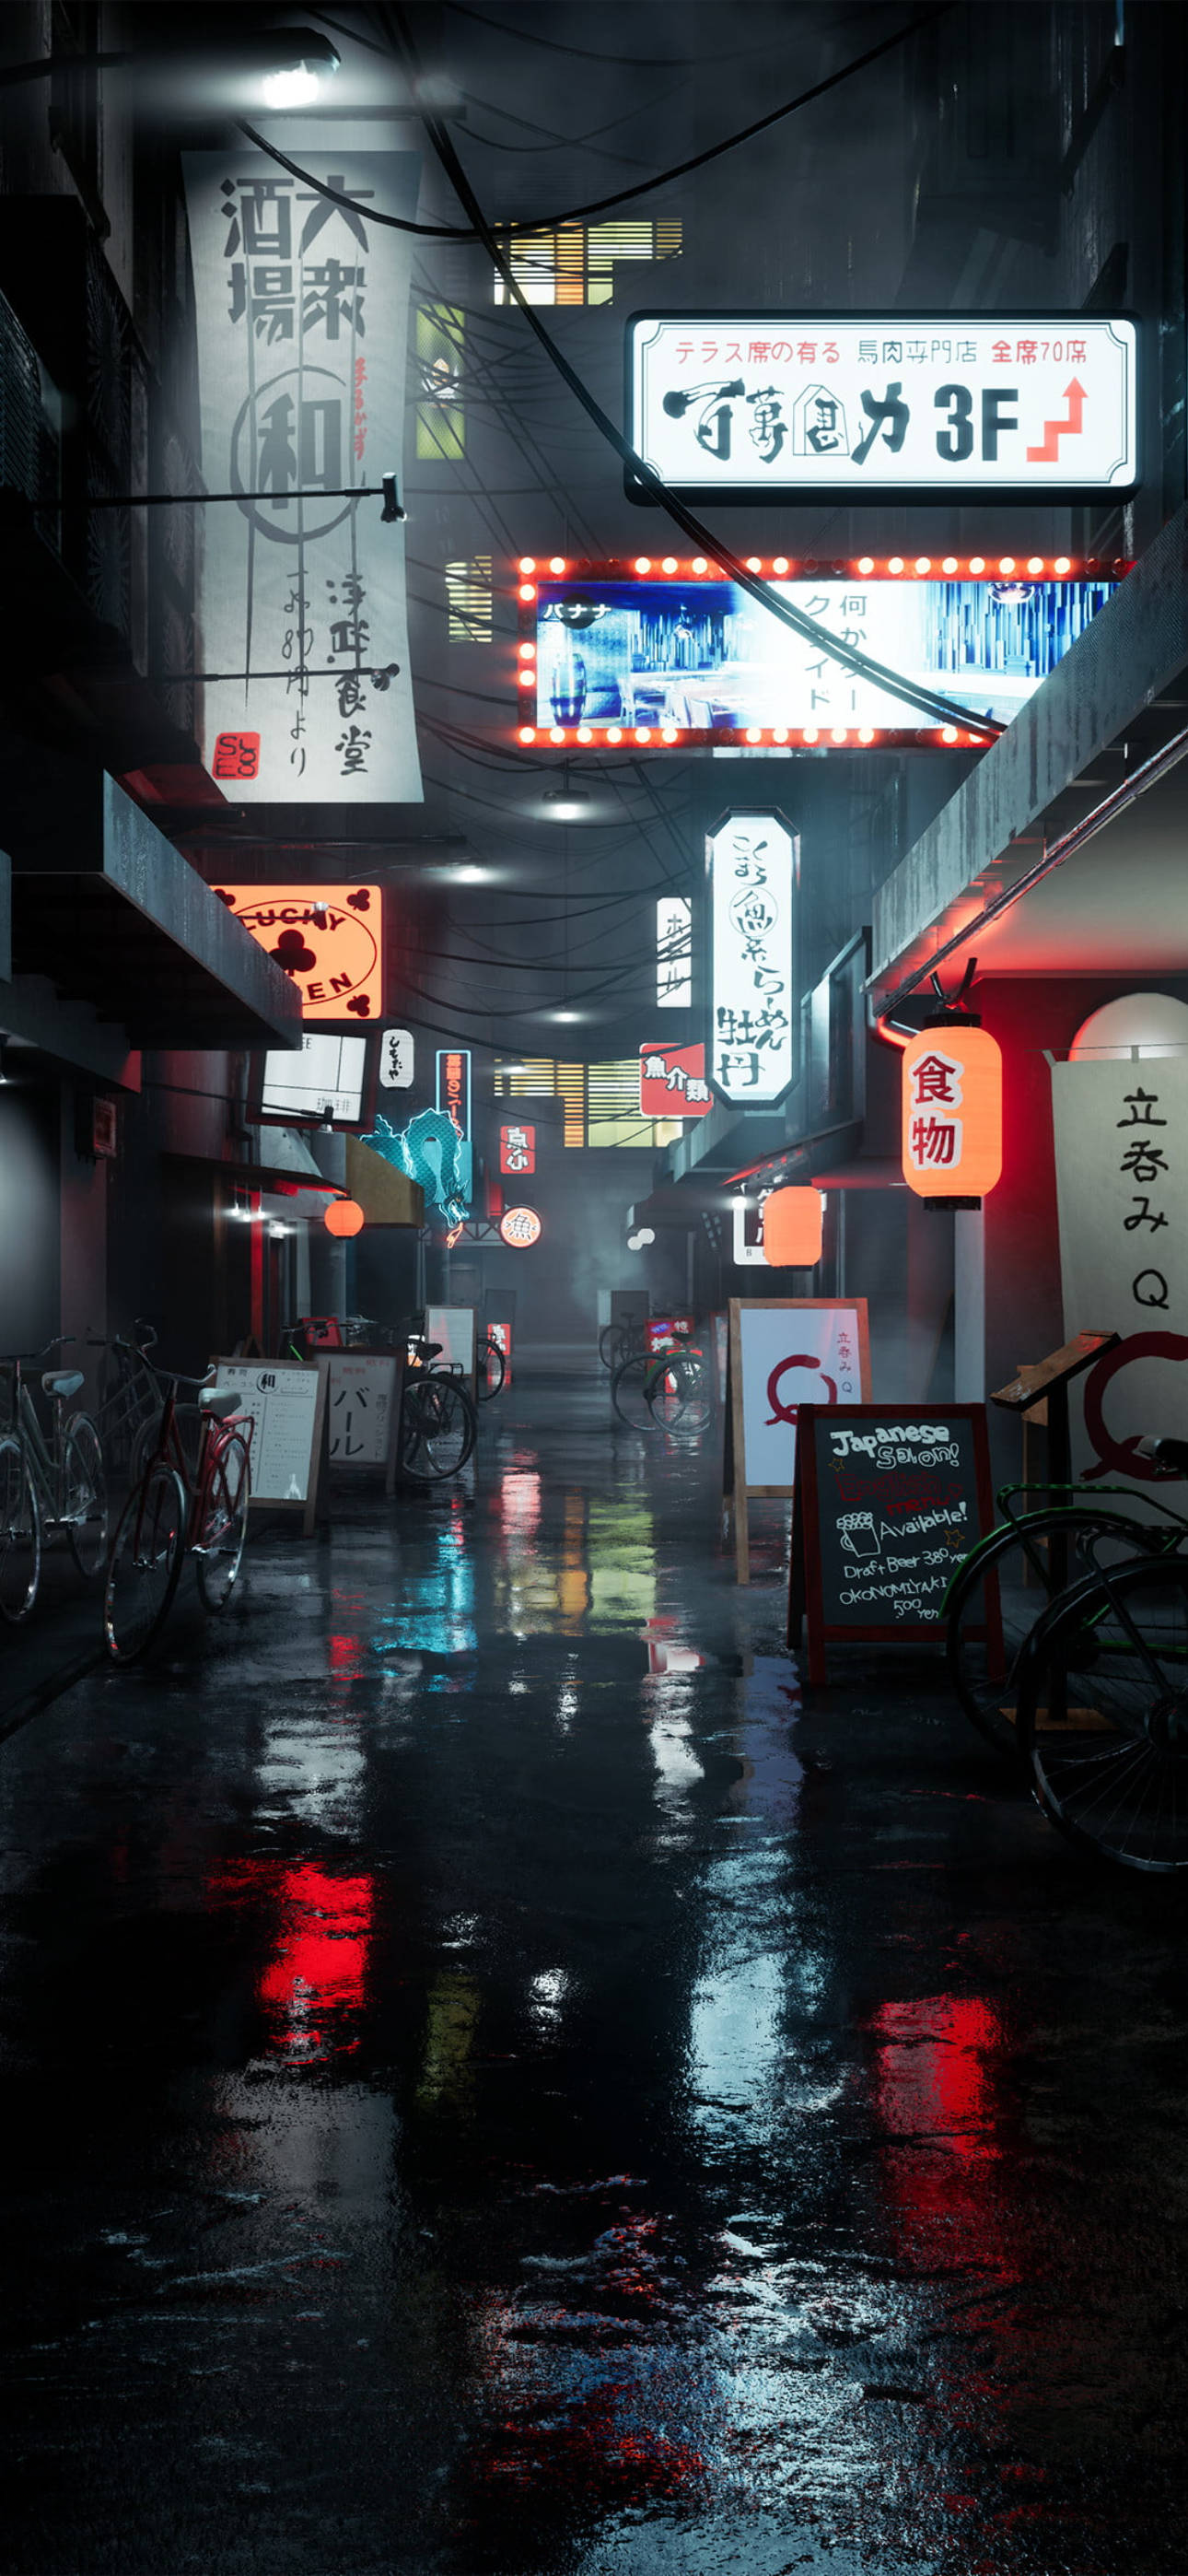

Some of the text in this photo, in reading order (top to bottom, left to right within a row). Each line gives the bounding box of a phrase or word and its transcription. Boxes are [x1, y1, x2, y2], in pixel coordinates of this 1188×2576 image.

[220, 178, 297, 346] 酒場
[675, 341, 840, 364] テラス席の有る
[991, 339, 1088, 364] 全席70席
[933, 384, 1019, 463] 3F
[257, 392, 343, 509] 和
[542, 603, 612, 620] バナナ
[913, 1055, 957, 1165] 食物
[1116, 1087, 1170, 1309] 立呑み Q
[830, 1424, 950, 1458] Japanese
[879, 1501, 969, 1541] Available!
[844, 1560, 886, 1580] Draft
[886, 1556, 921, 1574] Beer
[839, 1575, 949, 1605] OKONOMIYAKI
